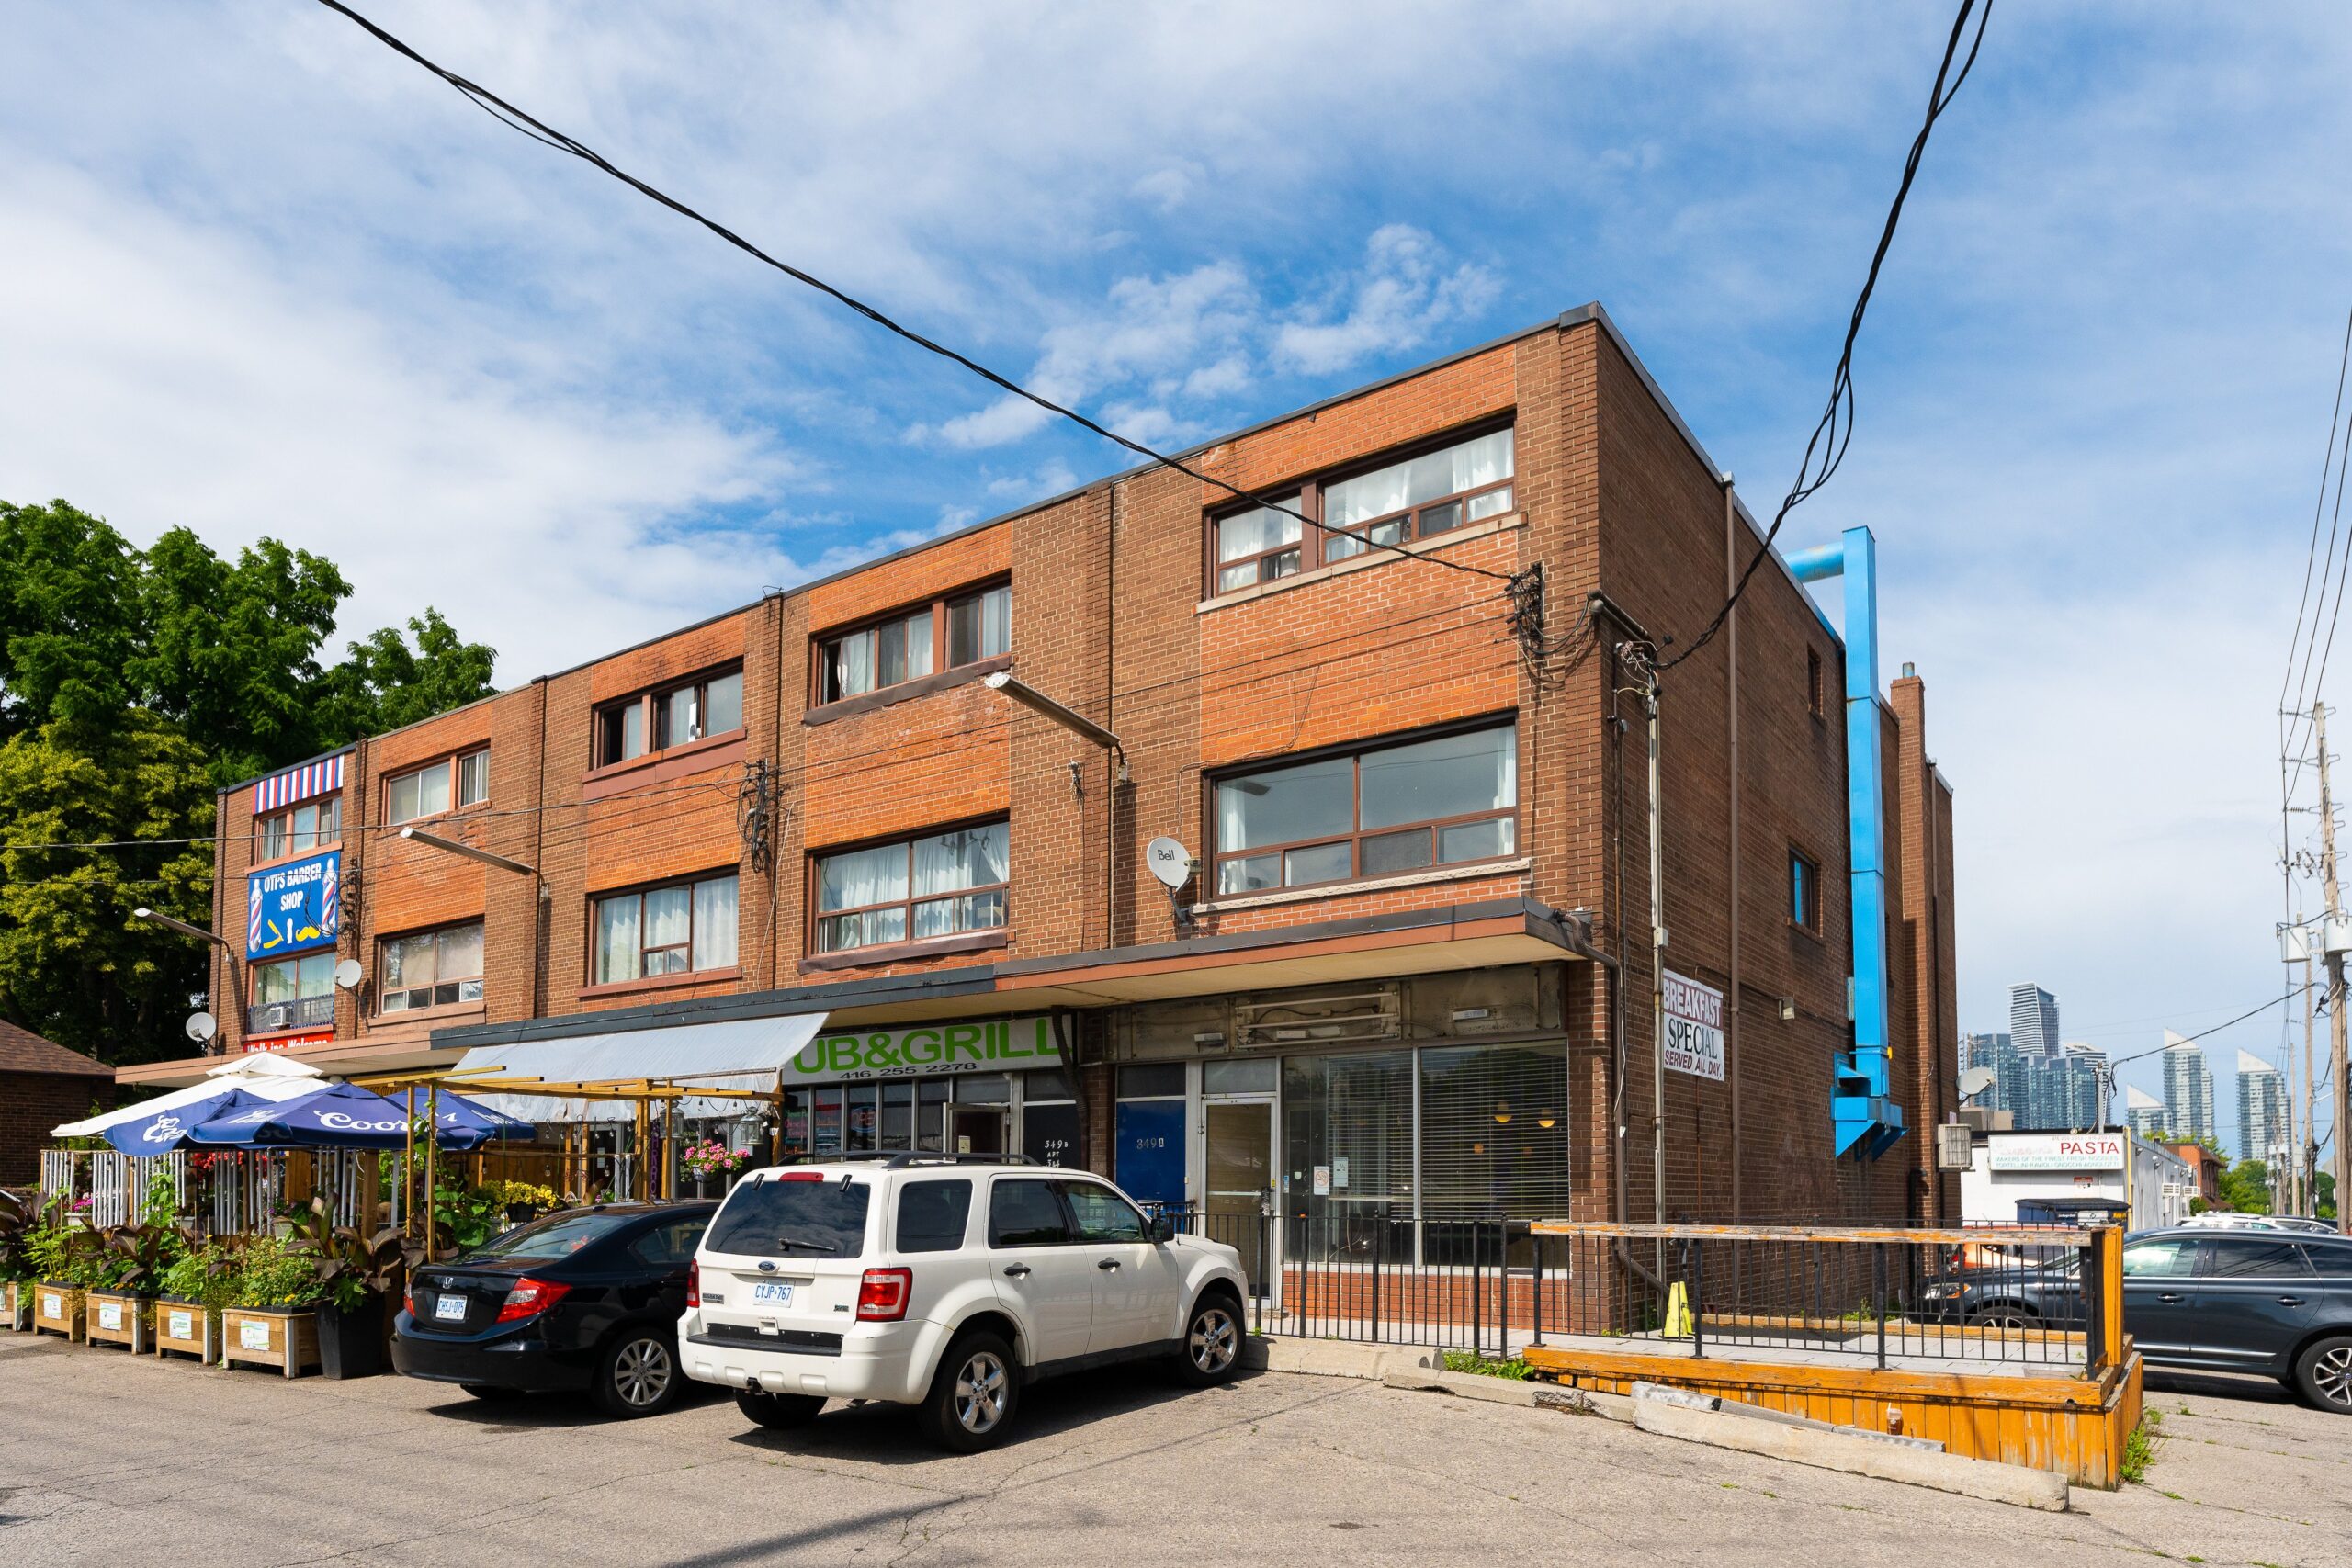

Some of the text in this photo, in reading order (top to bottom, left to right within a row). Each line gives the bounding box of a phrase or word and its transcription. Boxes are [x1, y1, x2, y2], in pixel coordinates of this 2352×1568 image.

[1157, 849, 1175, 861] Bell
[287, 863, 322, 887] BARBER
[280, 890, 304, 912] SHOP
[1663, 979, 1721, 1027] BREAKFAST
[1668, 1018, 1718, 1060] SPECIAL
[839, 1062, 977, 1079] 416 255 2278
[1664, 1049, 1693, 1070] SERVED
[1695, 1056, 1706, 1073] ALL
[2060, 1141, 2120, 1155] PASTA
